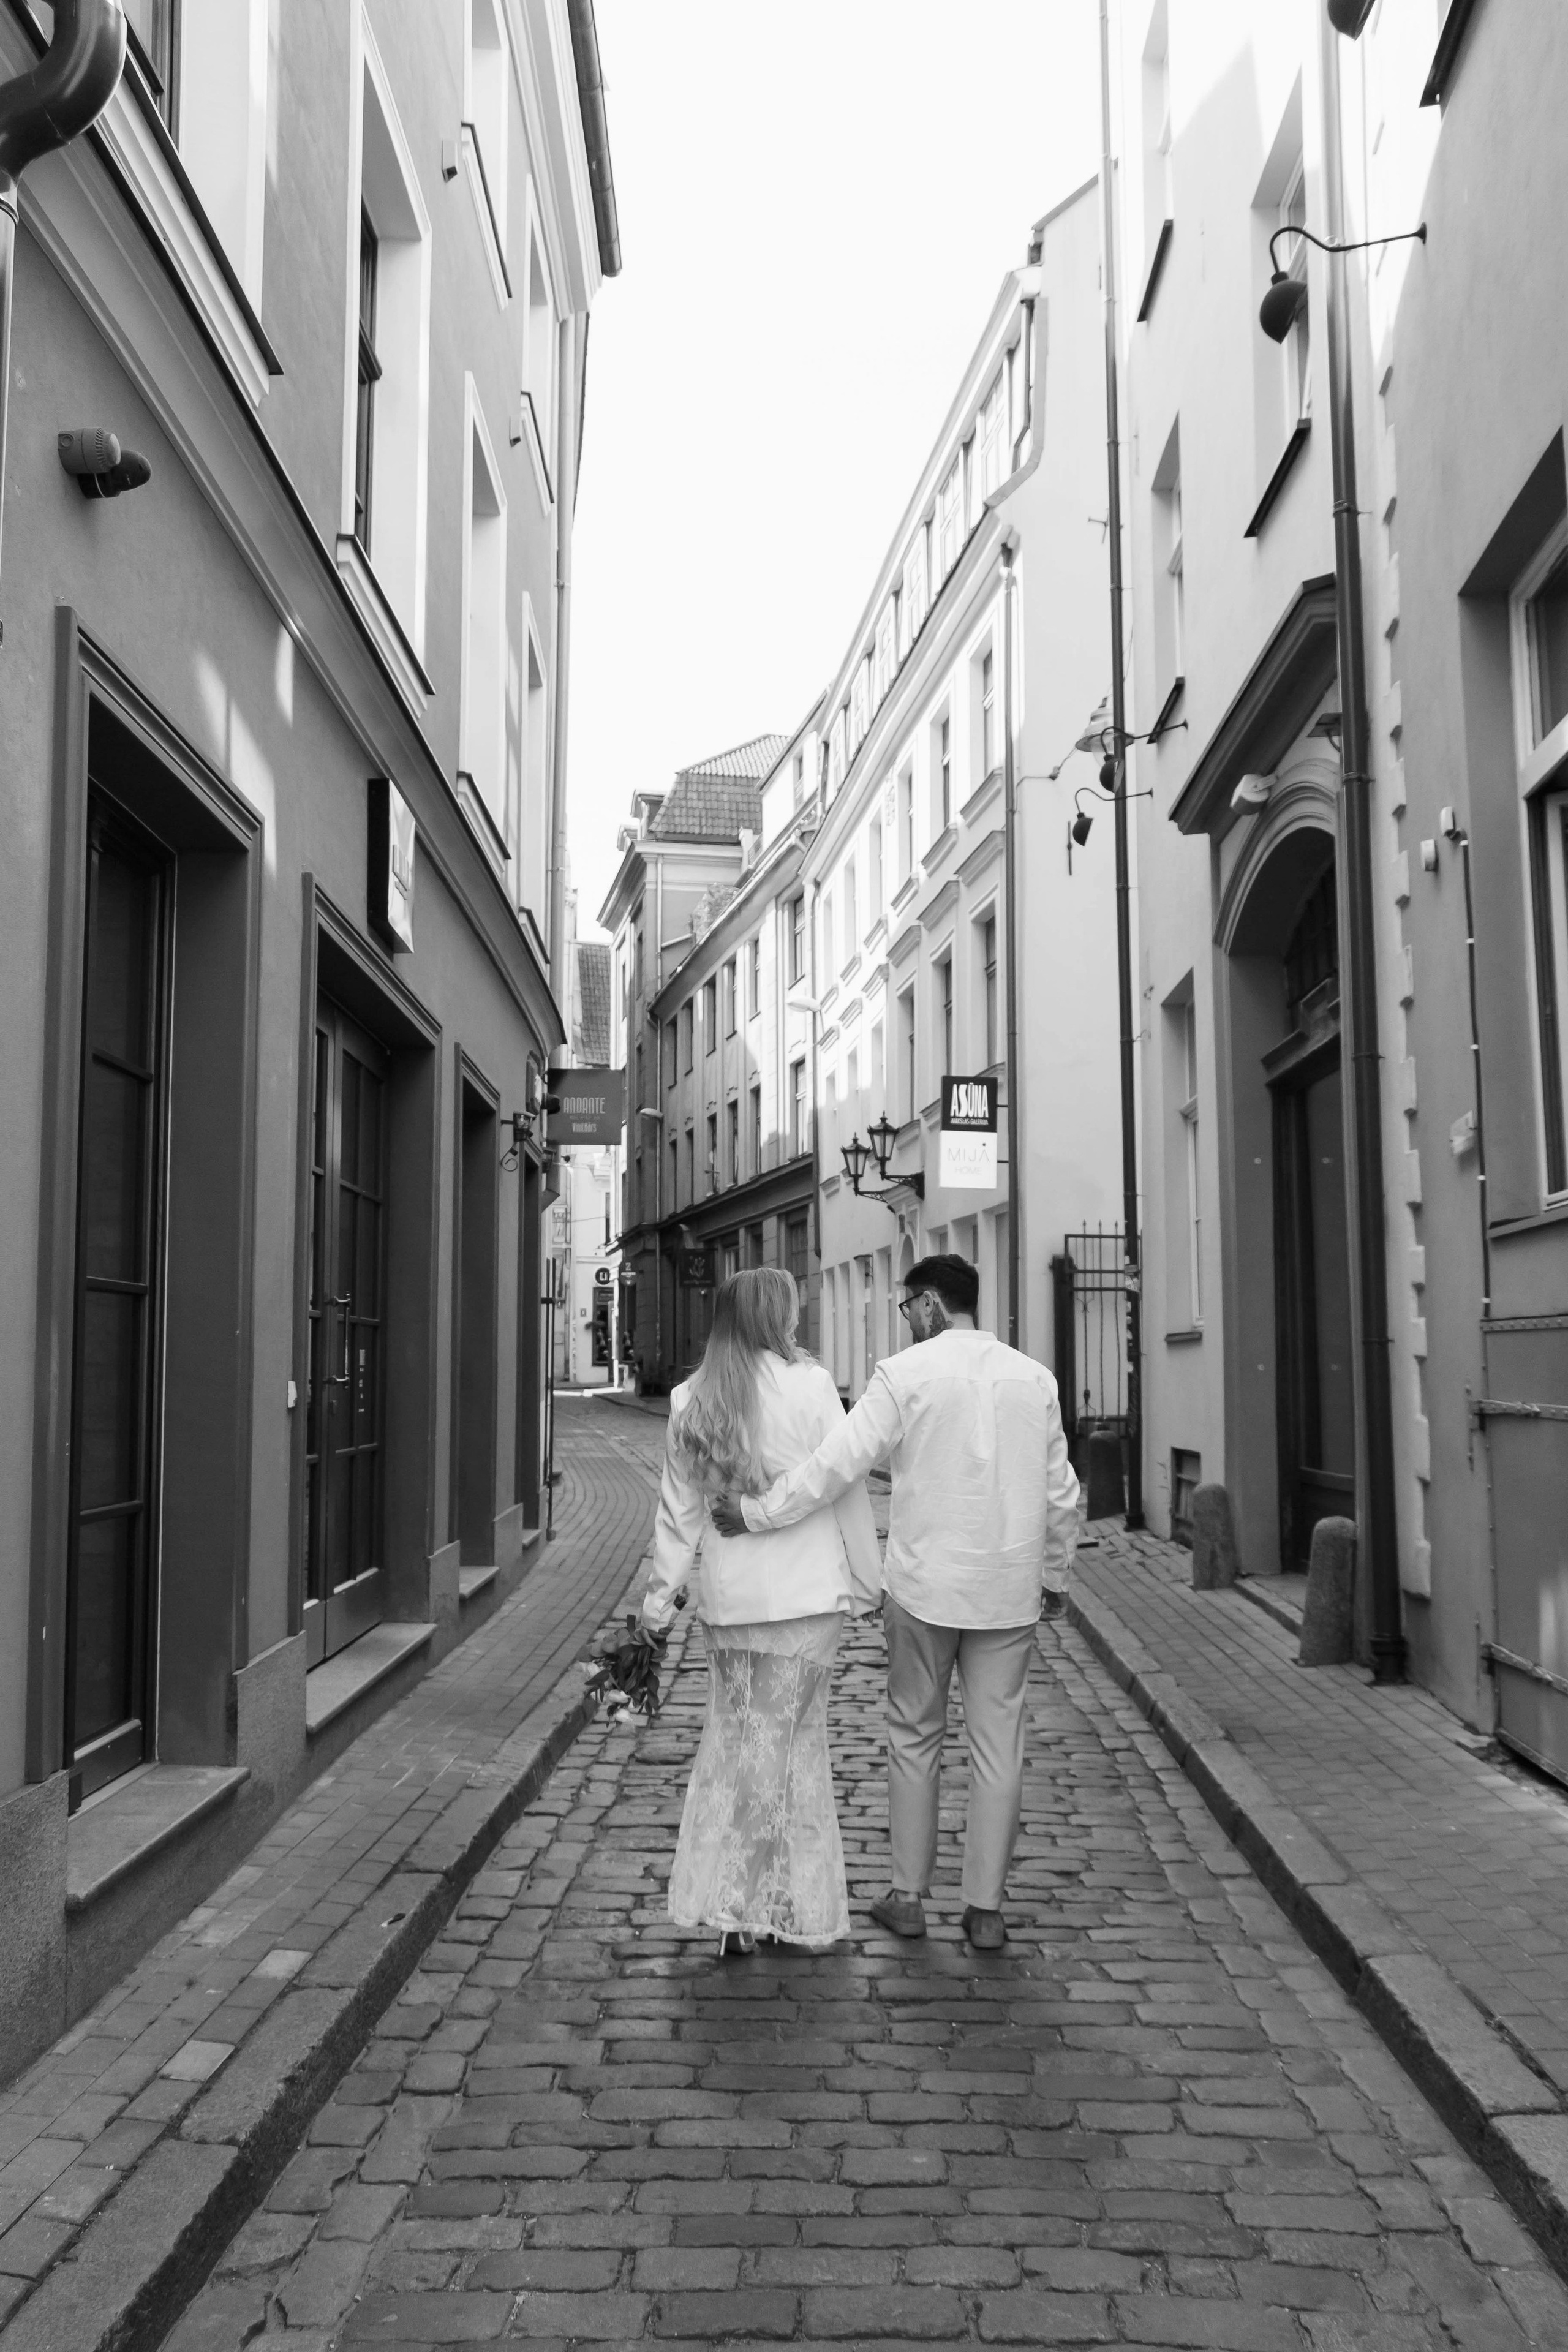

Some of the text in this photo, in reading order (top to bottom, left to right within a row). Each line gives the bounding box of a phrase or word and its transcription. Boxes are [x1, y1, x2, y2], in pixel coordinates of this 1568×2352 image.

[564, 1097, 606, 1114] ANDANTE
[950, 1082, 989, 1118] ASŪNA
[955, 1166, 982, 1175] HOME
